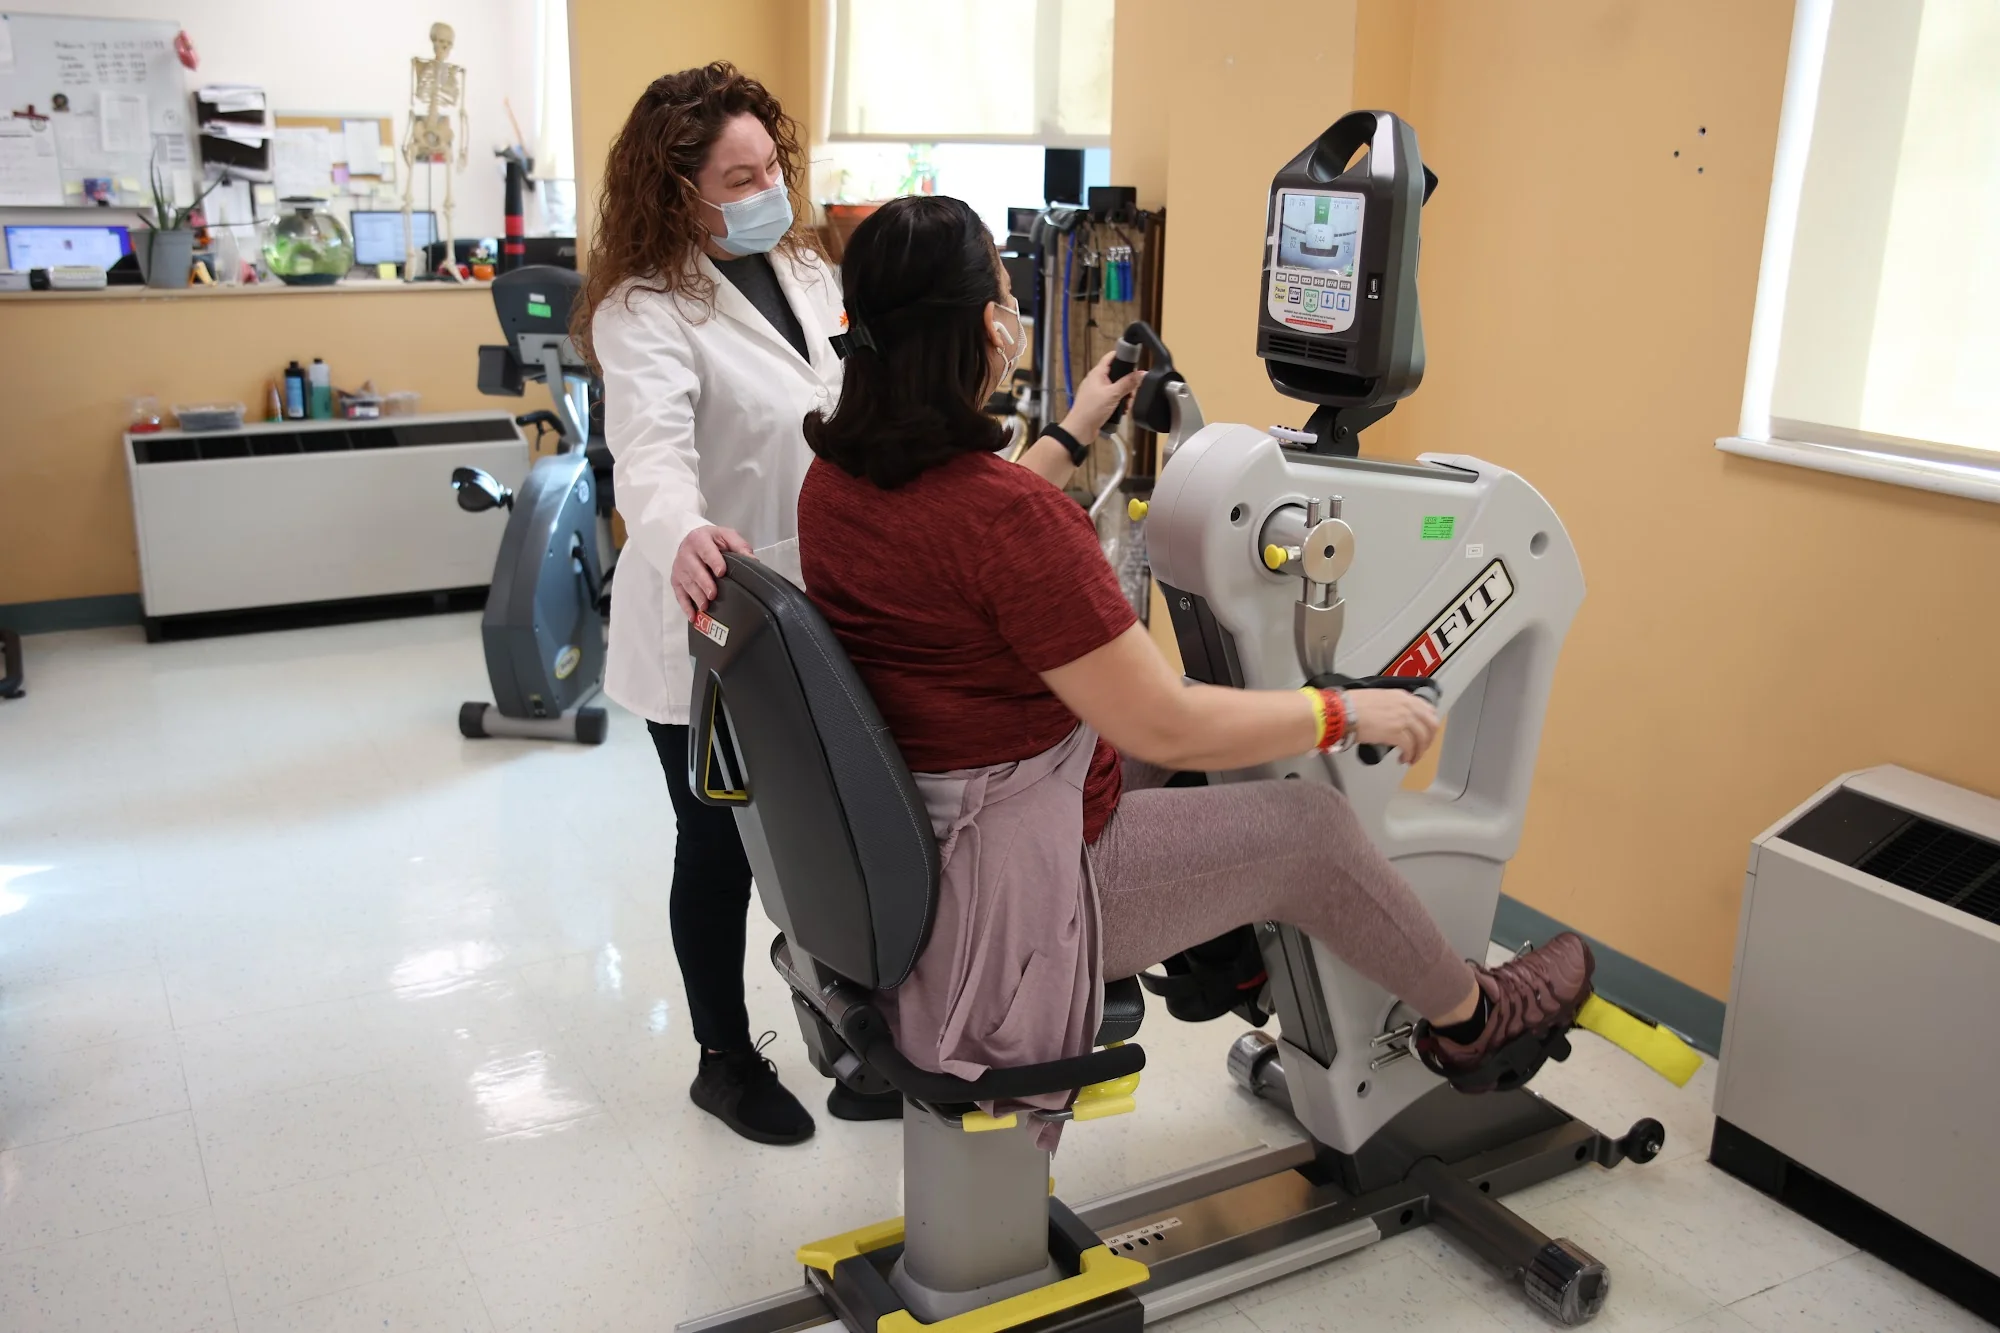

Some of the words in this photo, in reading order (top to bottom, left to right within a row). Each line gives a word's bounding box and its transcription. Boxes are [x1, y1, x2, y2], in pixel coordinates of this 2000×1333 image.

[1343, 245, 1350, 253] 12
[1289, 288, 1300, 296] Enter
[695, 614, 726, 641] SCIFIT
[1392, 573, 1496, 678] CIFIT
